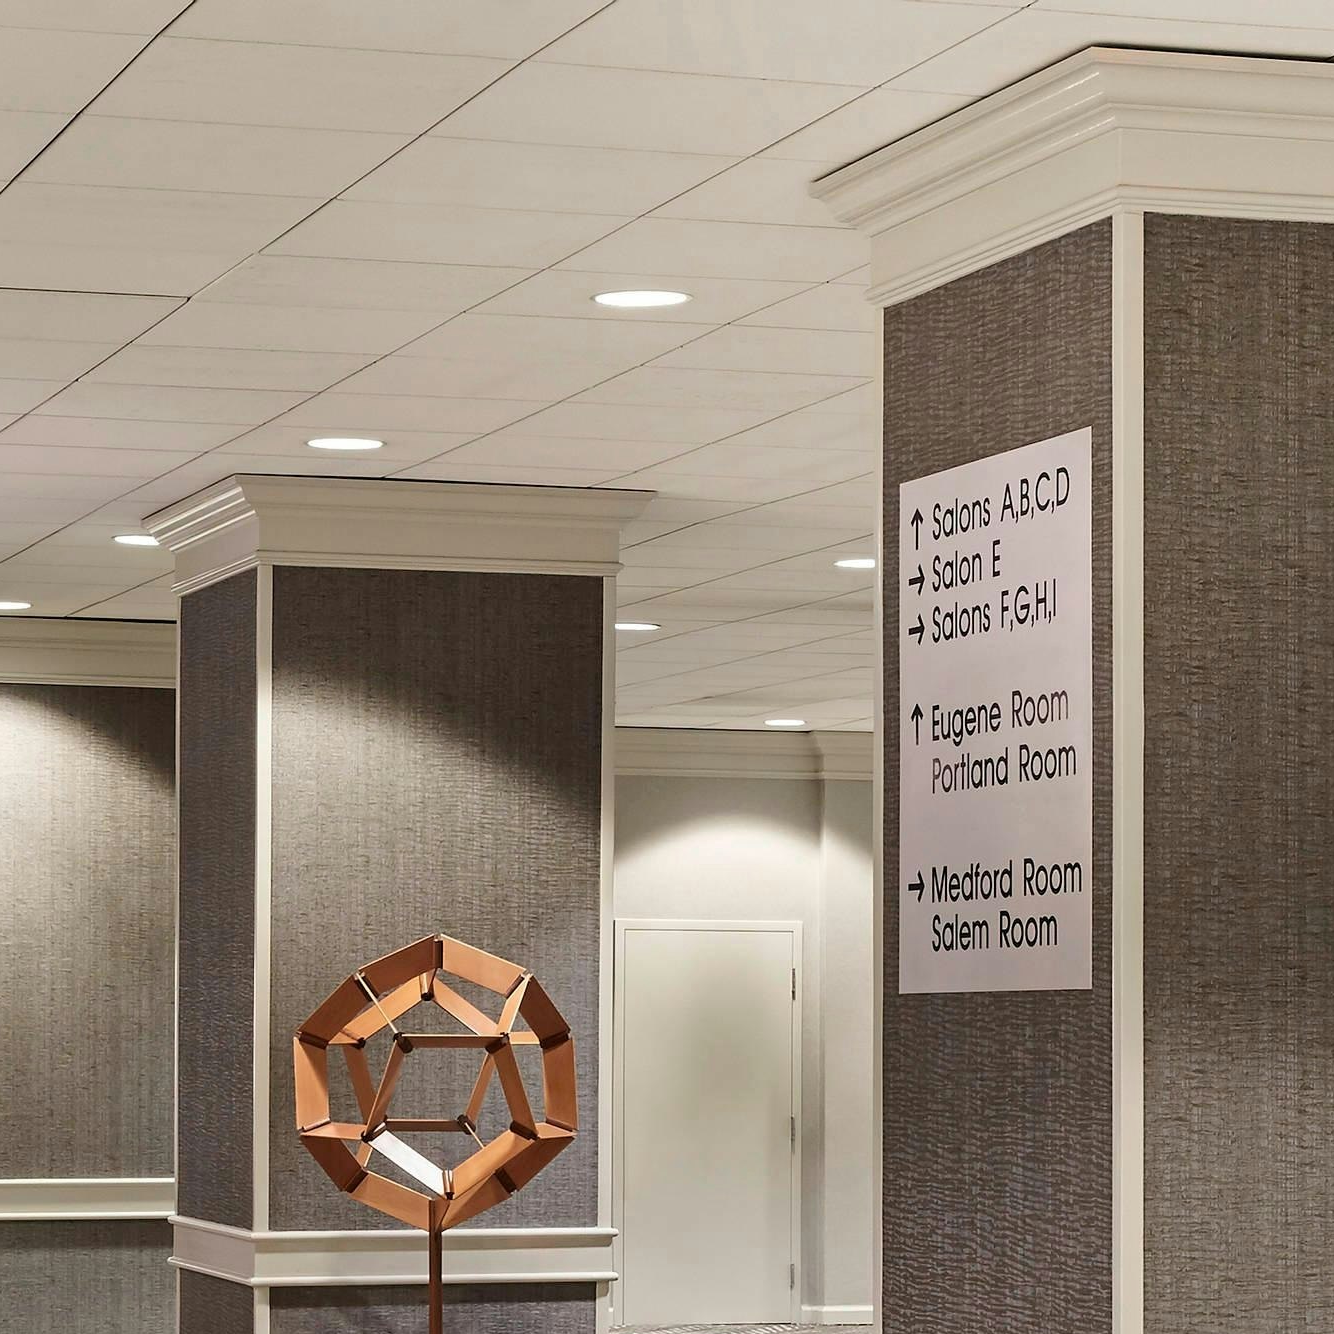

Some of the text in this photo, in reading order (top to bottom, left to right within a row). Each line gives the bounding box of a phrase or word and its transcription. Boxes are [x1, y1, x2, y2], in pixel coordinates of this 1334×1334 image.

[932, 466, 1070, 540] Salons A,B,C,D
[932, 539, 1001, 593] Salon E
[932, 578, 1056, 643] Salons F,G,H,I
[932, 690, 1069, 747] Eugene Room
[932, 744, 1076, 794] Portland Room
[931, 857, 1082, 903] Medford Room
[932, 910, 1058, 952] Salem Room
